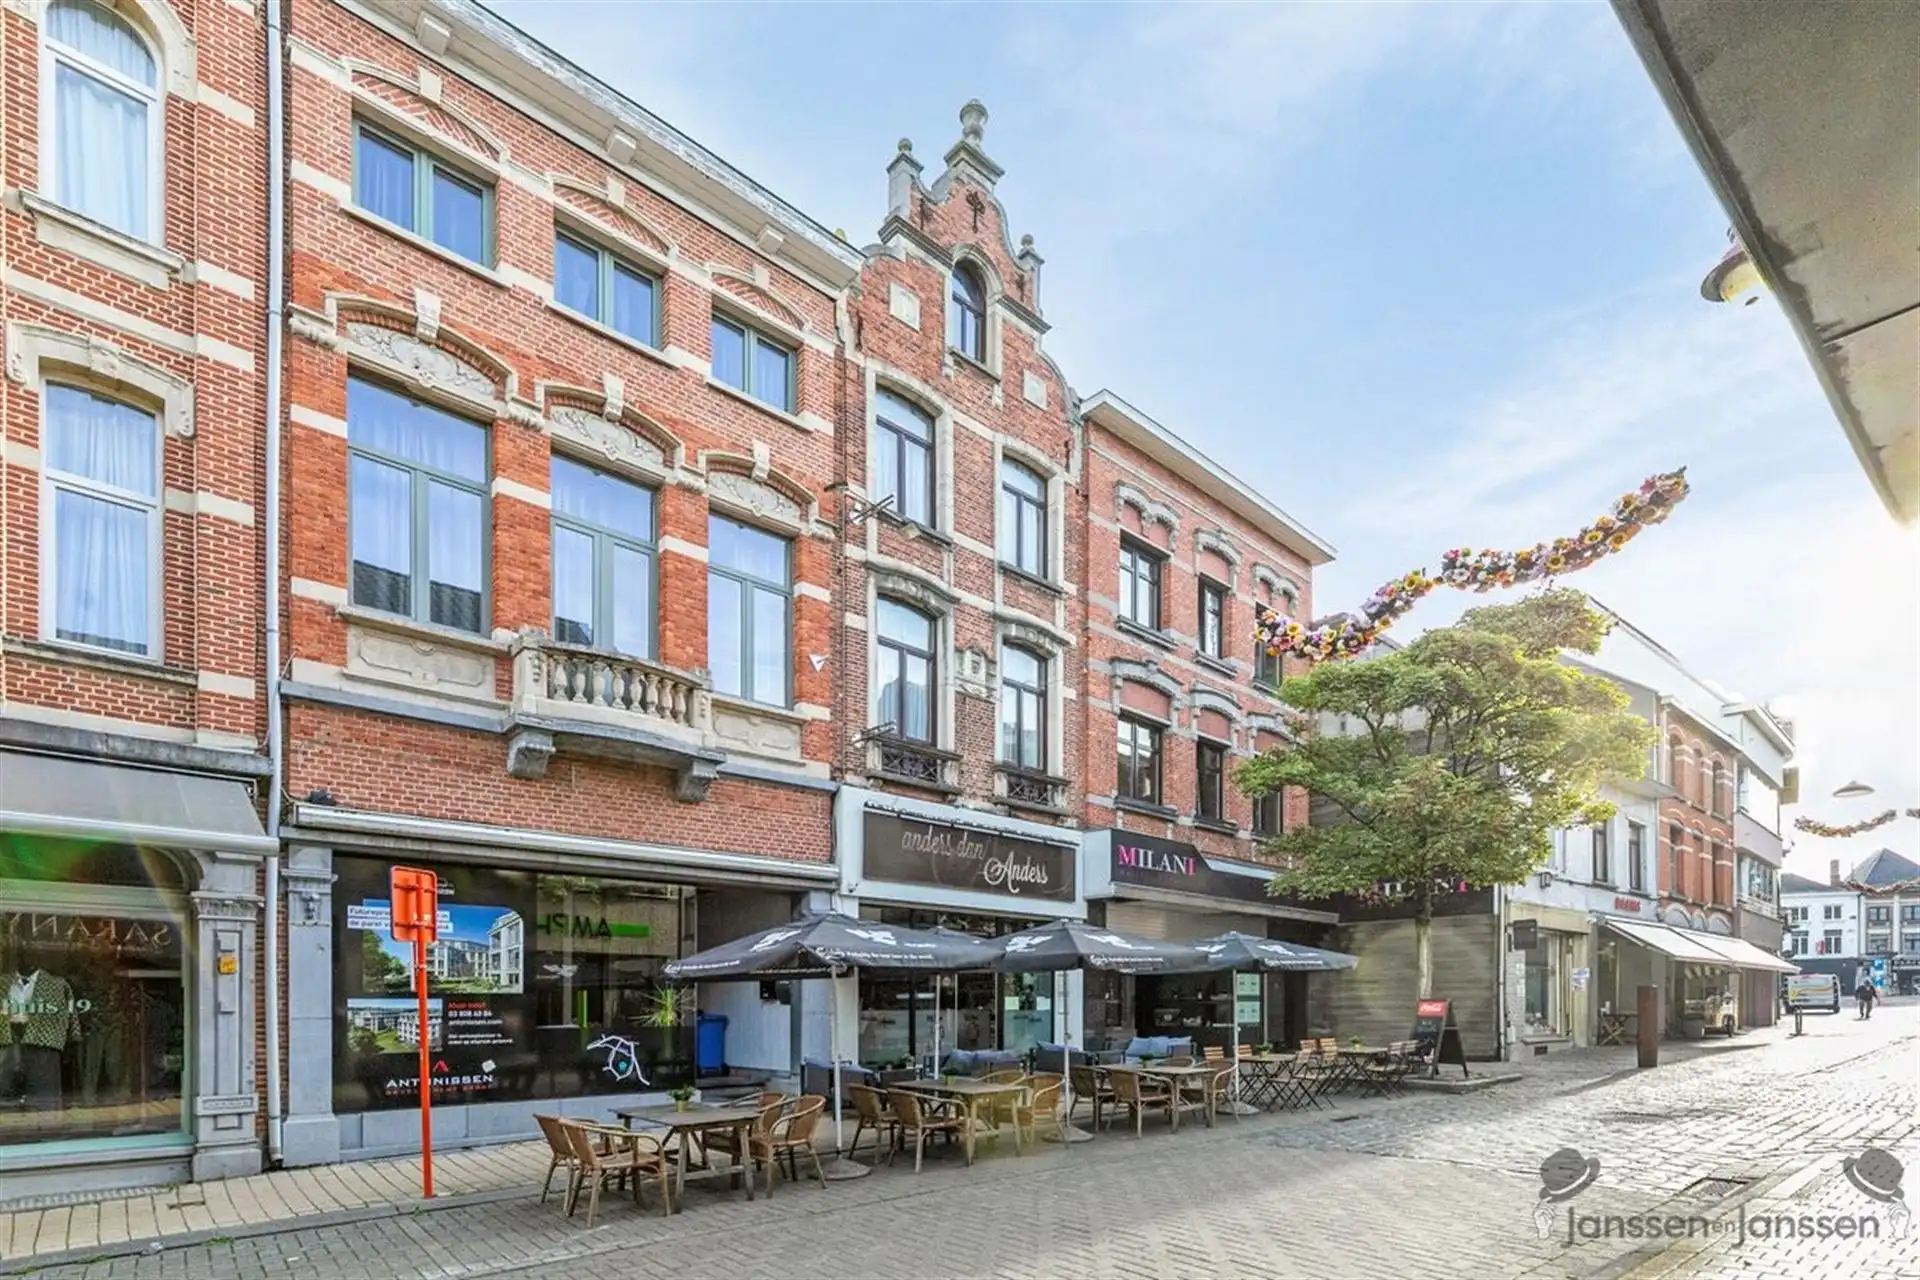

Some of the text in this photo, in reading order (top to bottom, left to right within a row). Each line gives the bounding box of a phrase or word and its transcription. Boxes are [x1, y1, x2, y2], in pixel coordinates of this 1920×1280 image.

[901, 824, 986, 861] anders dan
[983, 851, 1049, 894] Anders
[1117, 844, 1197, 877] MILANI
[68, 998, 92, 1014] 19
[386, 1074, 493, 1088] ANTNISSEN
